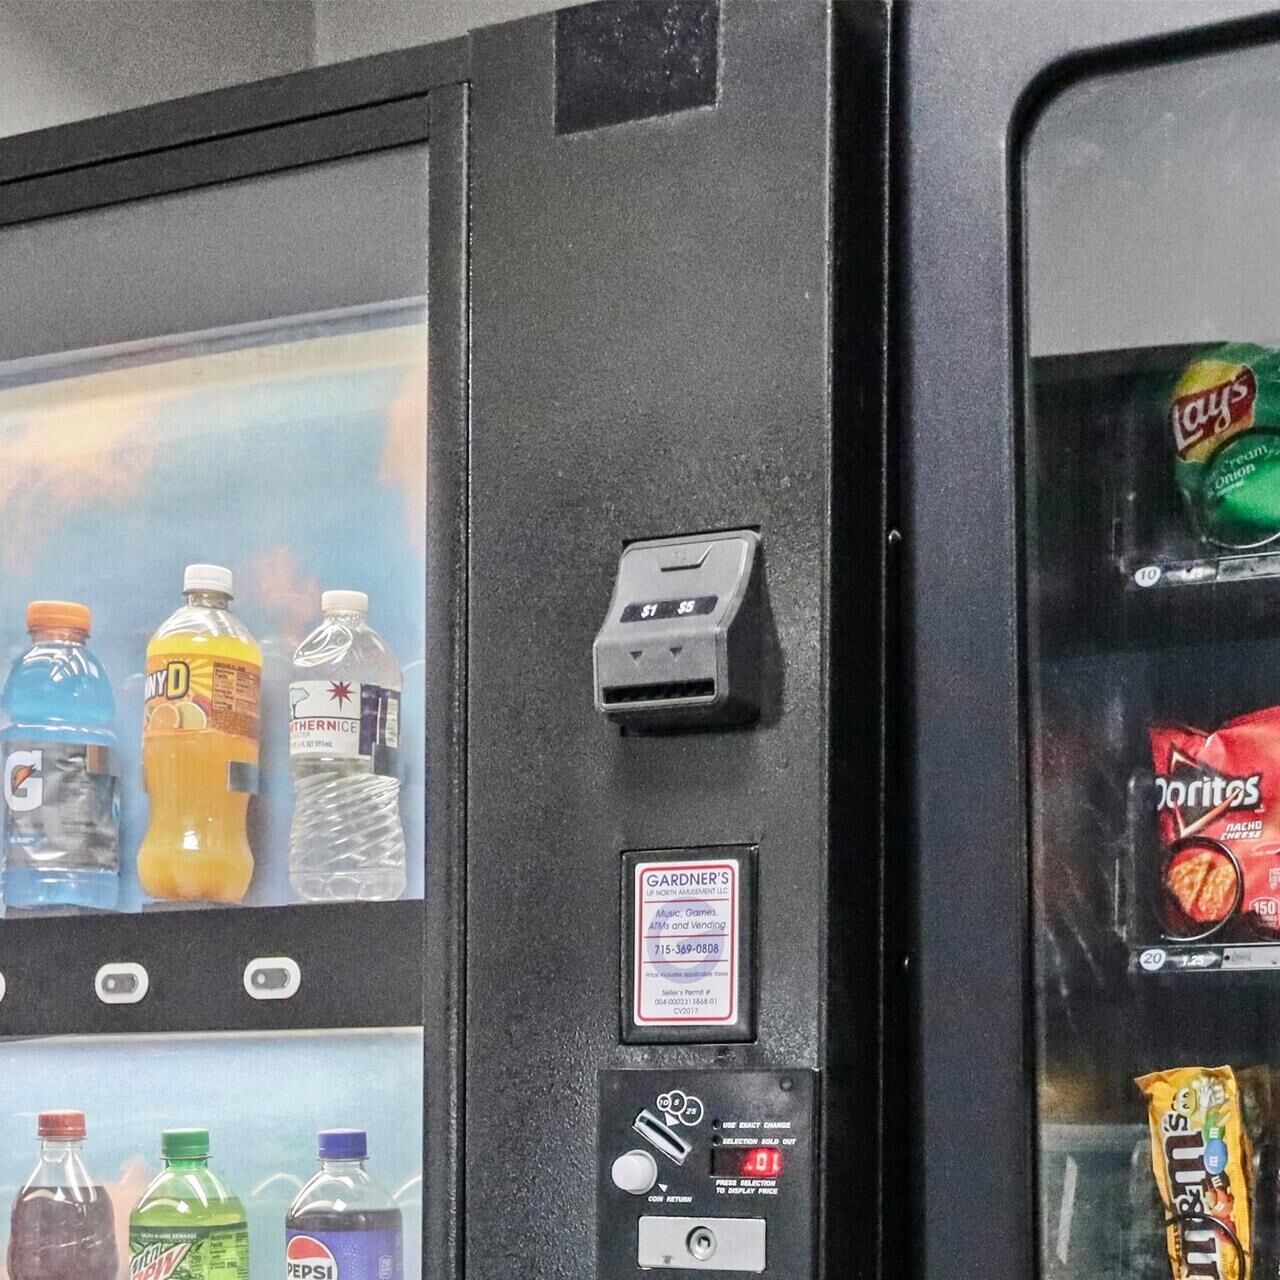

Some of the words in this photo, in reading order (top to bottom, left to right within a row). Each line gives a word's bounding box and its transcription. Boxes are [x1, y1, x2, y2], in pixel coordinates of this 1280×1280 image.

[1140, 568, 1157, 580] 10
[641, 604, 658, 619] $1
[677, 600, 696, 616] $5
[3, 750, 43, 812] G
[1226, 821, 1262, 832] NACHO
[1220, 831, 1262, 841] CHEESE
[646, 872, 729, 888] GARDNER'S
[655, 909, 683, 918] Music,
[685, 908, 718, 917] Games,
[1253, 901, 1276, 915] 150
[649, 922, 670, 930] ATMs
[671, 921, 689, 930] and
[691, 920, 727, 931] Vending
[654, 944, 719, 955] 715-369-0808
[1143, 952, 1161, 964] 20
[728, 1187, 755, 1195] DISPLAY
[287, 1262, 333, 1280] PEPSI
